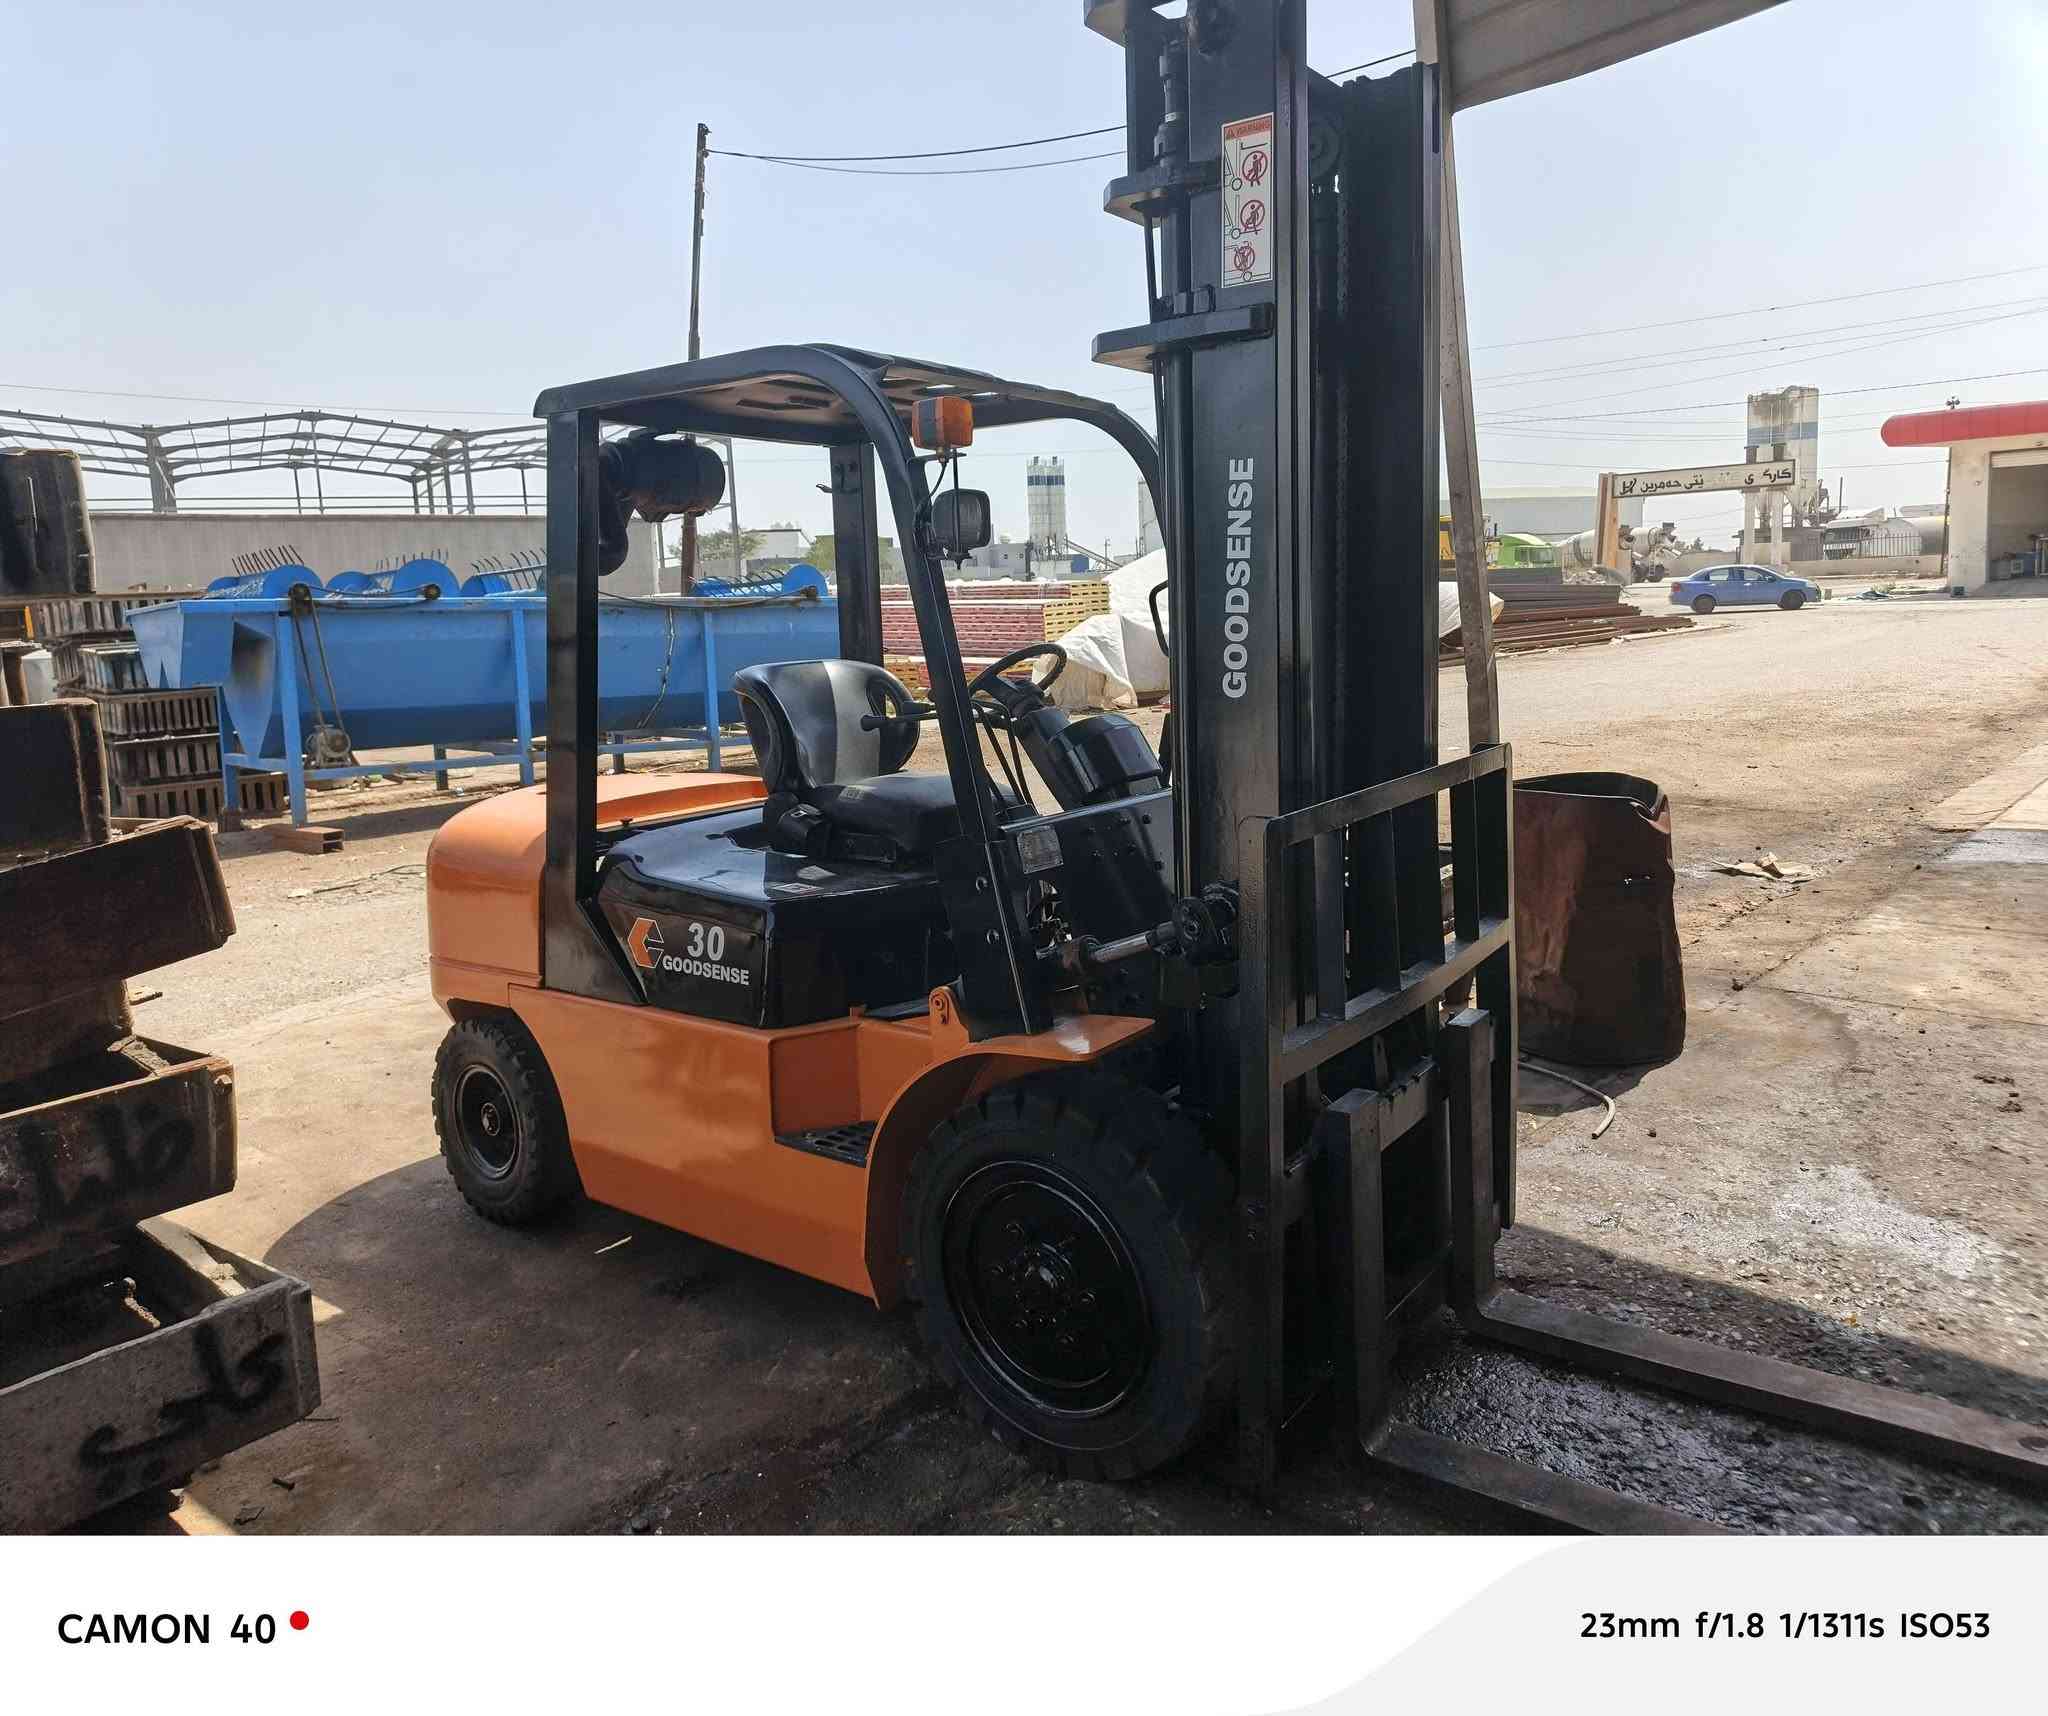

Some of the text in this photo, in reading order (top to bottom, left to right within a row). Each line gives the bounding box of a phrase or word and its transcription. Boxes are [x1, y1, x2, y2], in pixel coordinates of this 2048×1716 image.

[1222, 458, 1254, 698] GOODSENSE
[687, 922, 725, 961] 30
[662, 955, 750, 986] GOODSENSE
